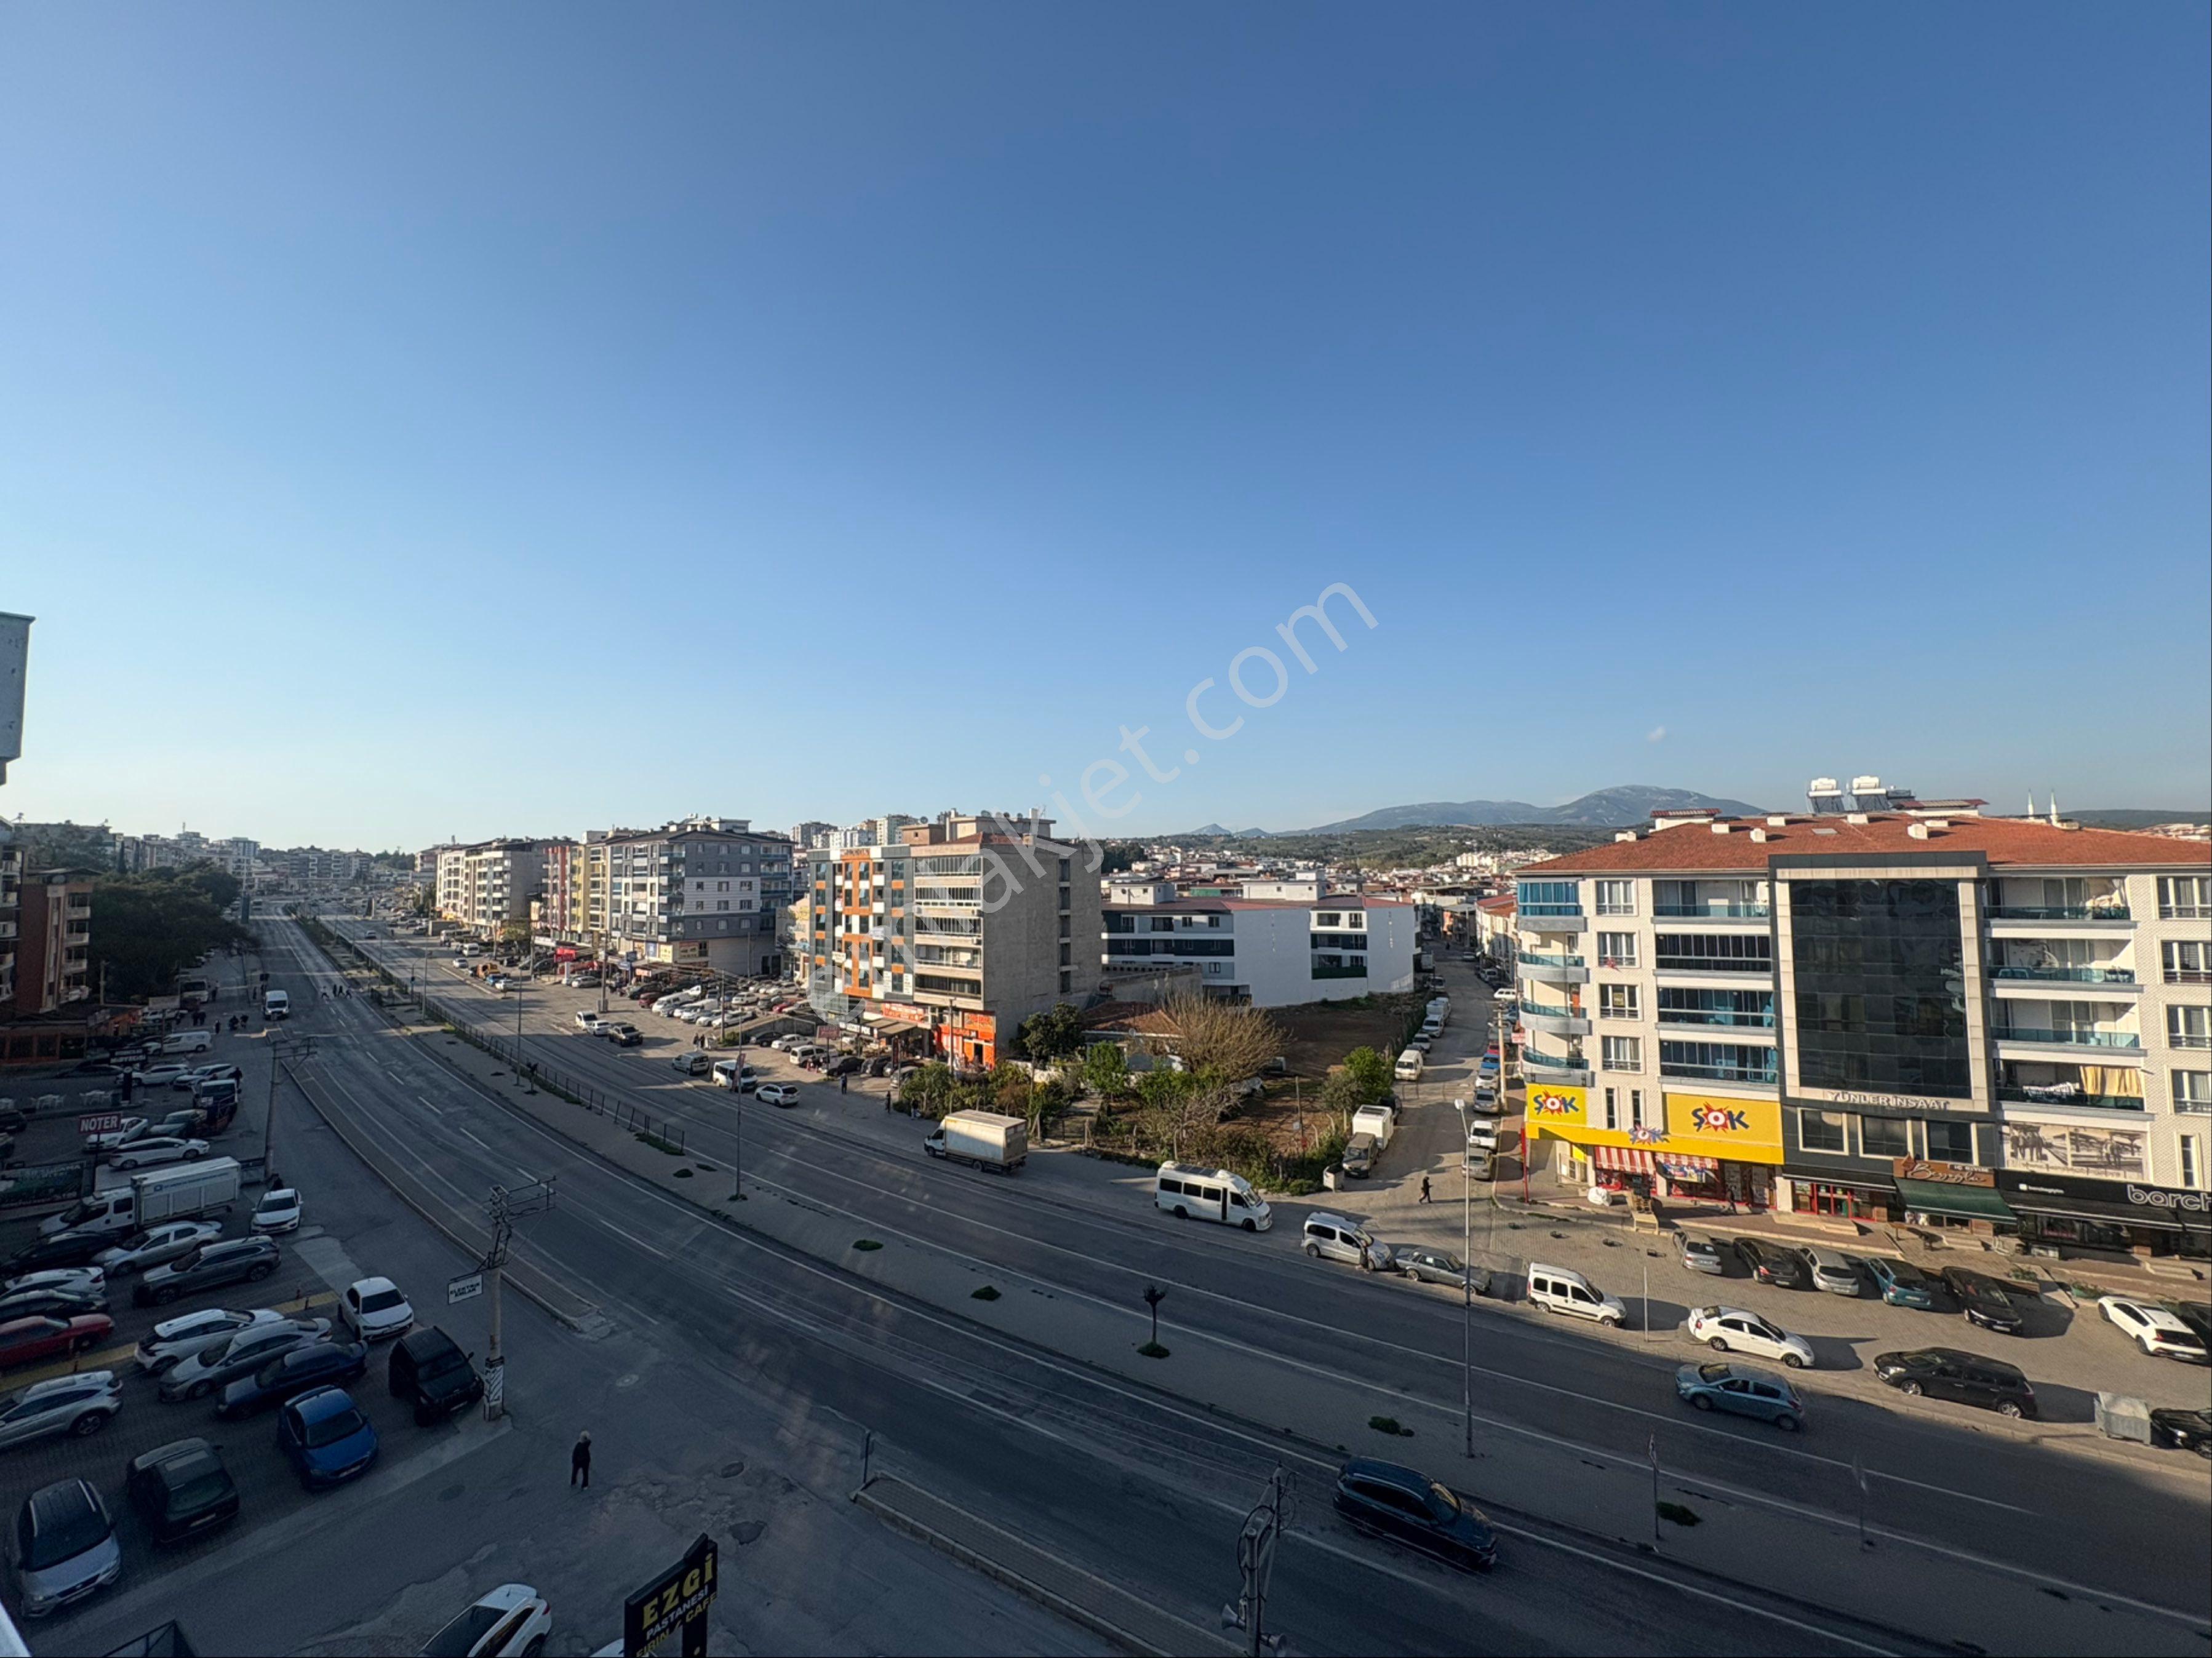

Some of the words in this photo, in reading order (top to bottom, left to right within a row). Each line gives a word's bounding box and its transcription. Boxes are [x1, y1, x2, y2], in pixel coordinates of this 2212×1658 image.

[1533, 1093, 1579, 1115] ŞOK
[80, 1115, 118, 1132] NOTER
[1691, 1106, 1750, 1133] ŞOK
[642, 1553, 713, 1630] EZGİ
[646, 1583, 708, 1641] PASTANESİ
[685, 1592, 717, 1623] CAFE
